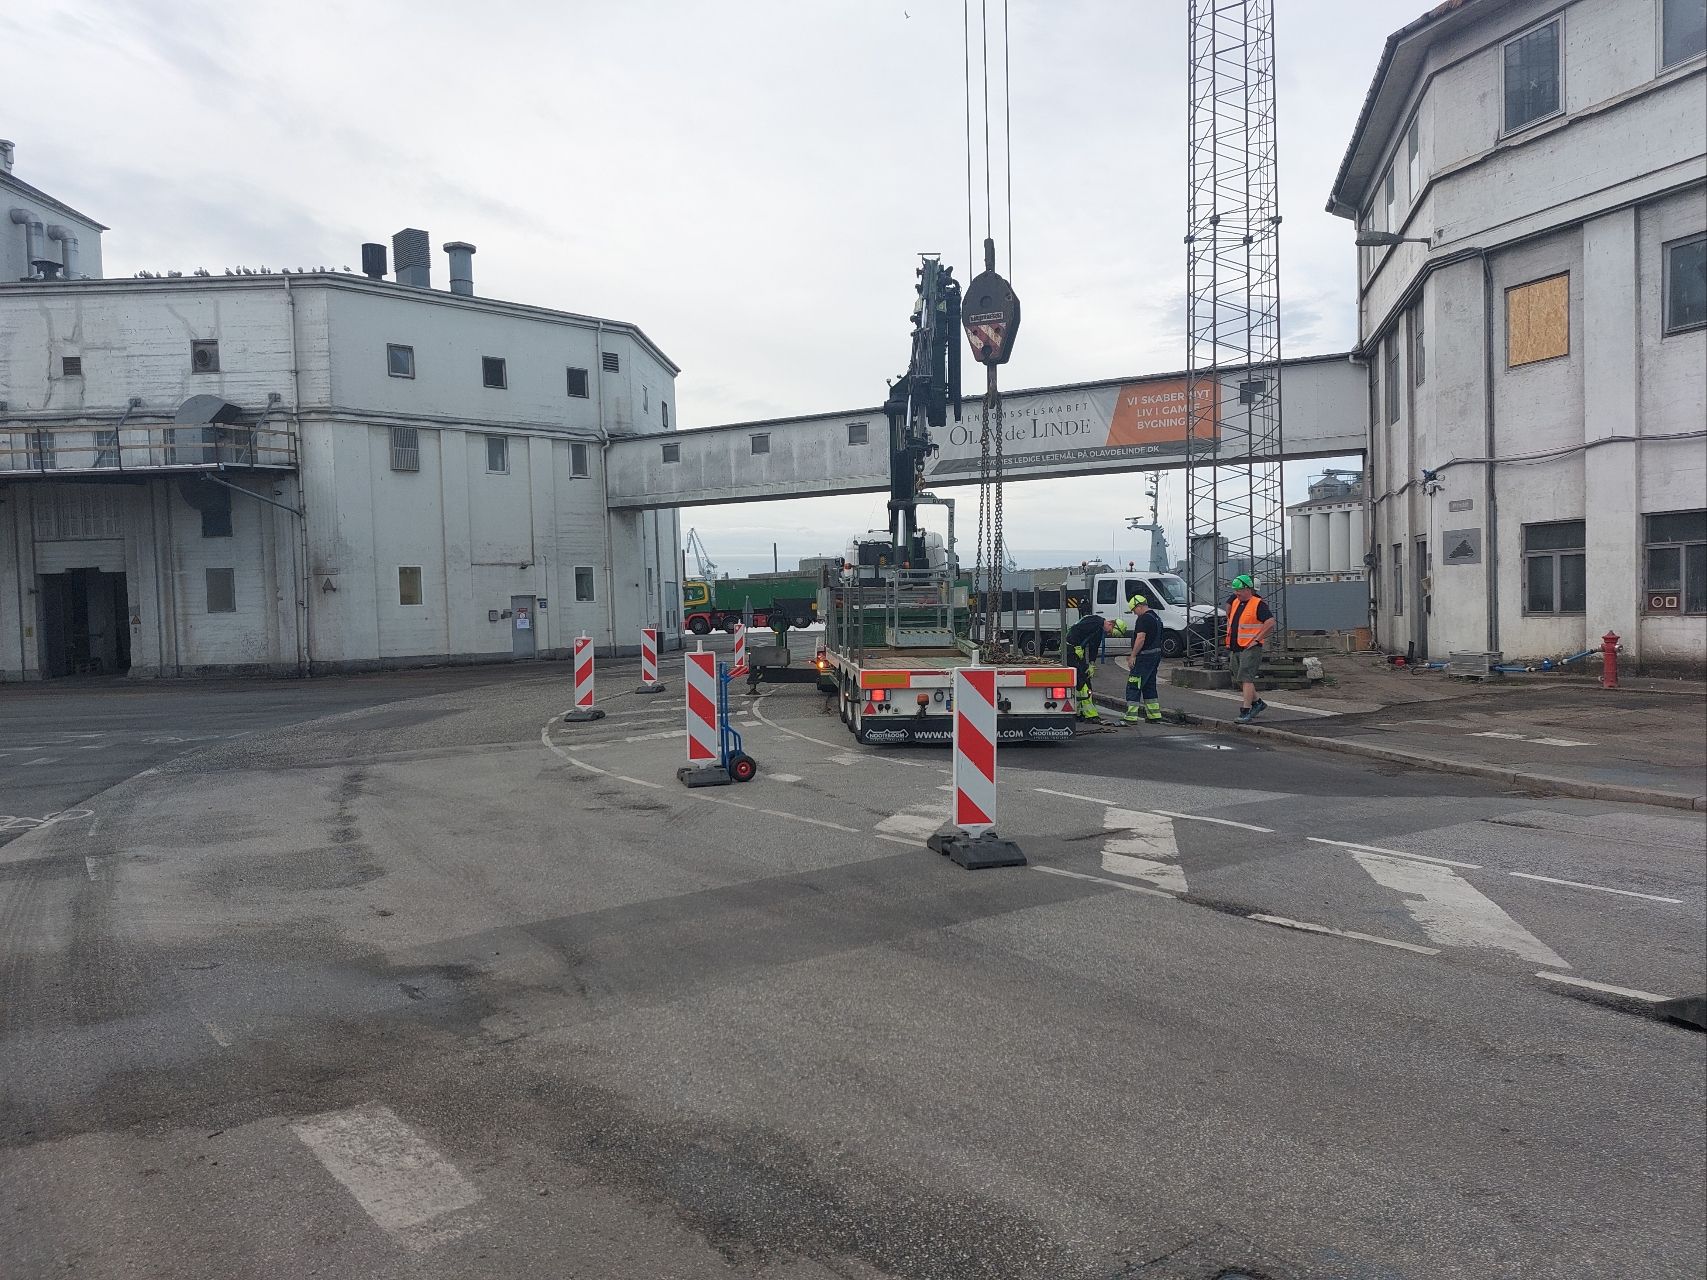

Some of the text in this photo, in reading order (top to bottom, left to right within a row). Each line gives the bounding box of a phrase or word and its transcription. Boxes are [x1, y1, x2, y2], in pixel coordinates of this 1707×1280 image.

[1127, 396, 1138, 406] VI
[1141, 392, 1185, 404] SKABER
[954, 402, 1088, 424] JENOMSSELSKABET
[1137, 408, 1152, 417] LIV
[950, 418, 1091, 446] OLV de LINDE
[1014, 454, 1041, 464] LEDIGE
[1042, 451, 1076, 463] LEJEMÅL
[1077, 450, 1087, 459] PÅ
